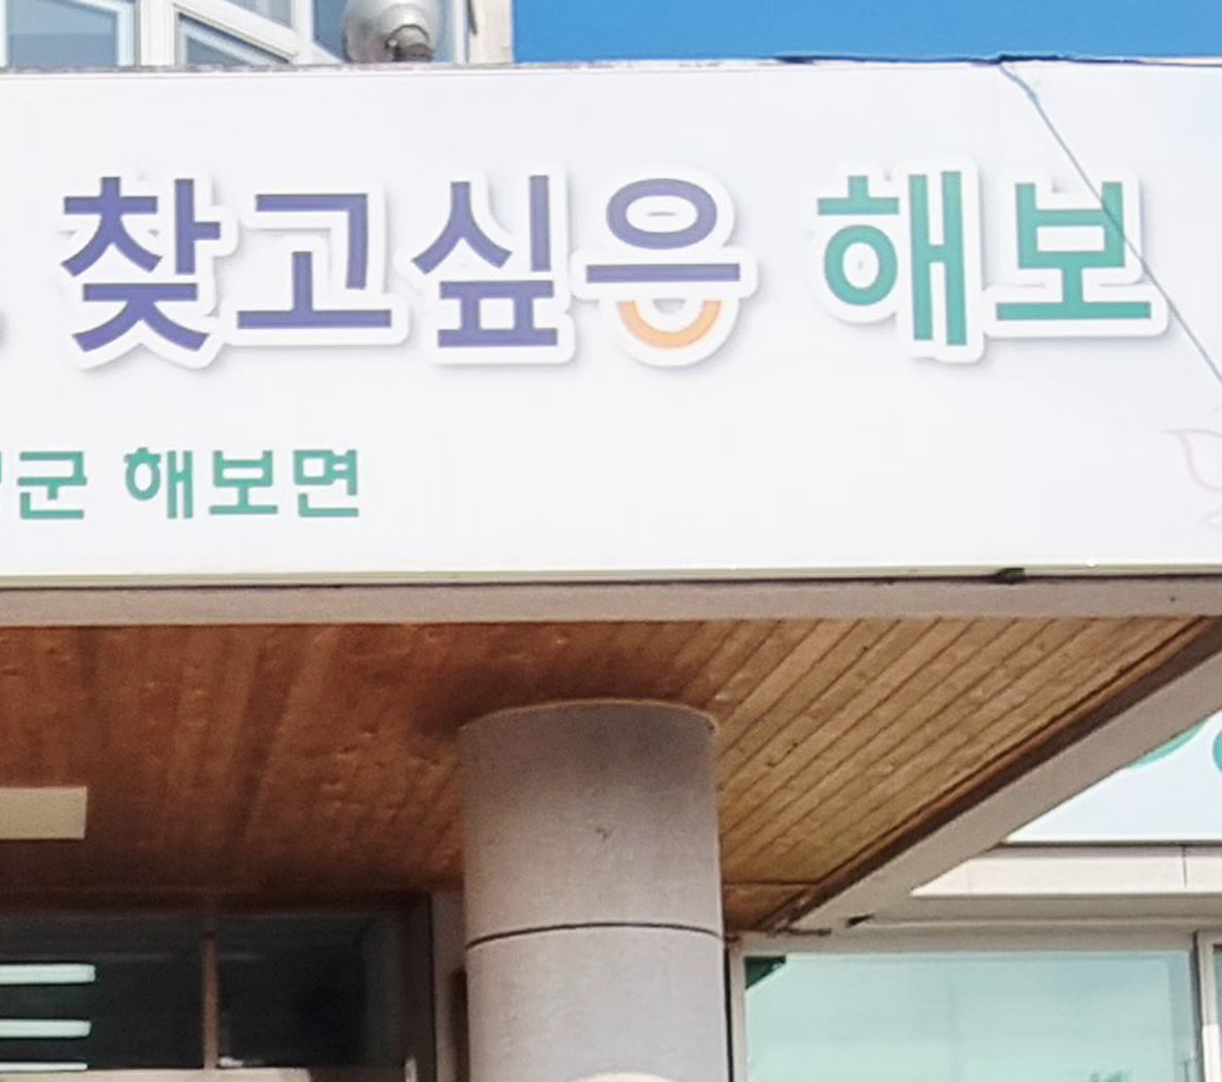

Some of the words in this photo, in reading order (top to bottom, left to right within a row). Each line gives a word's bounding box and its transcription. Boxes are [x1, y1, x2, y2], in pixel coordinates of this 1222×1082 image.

[59, 173, 742, 353] 찾고싶은
[815, 169, 1153, 347] 해보
[123, 445, 361, 519] 해보면
